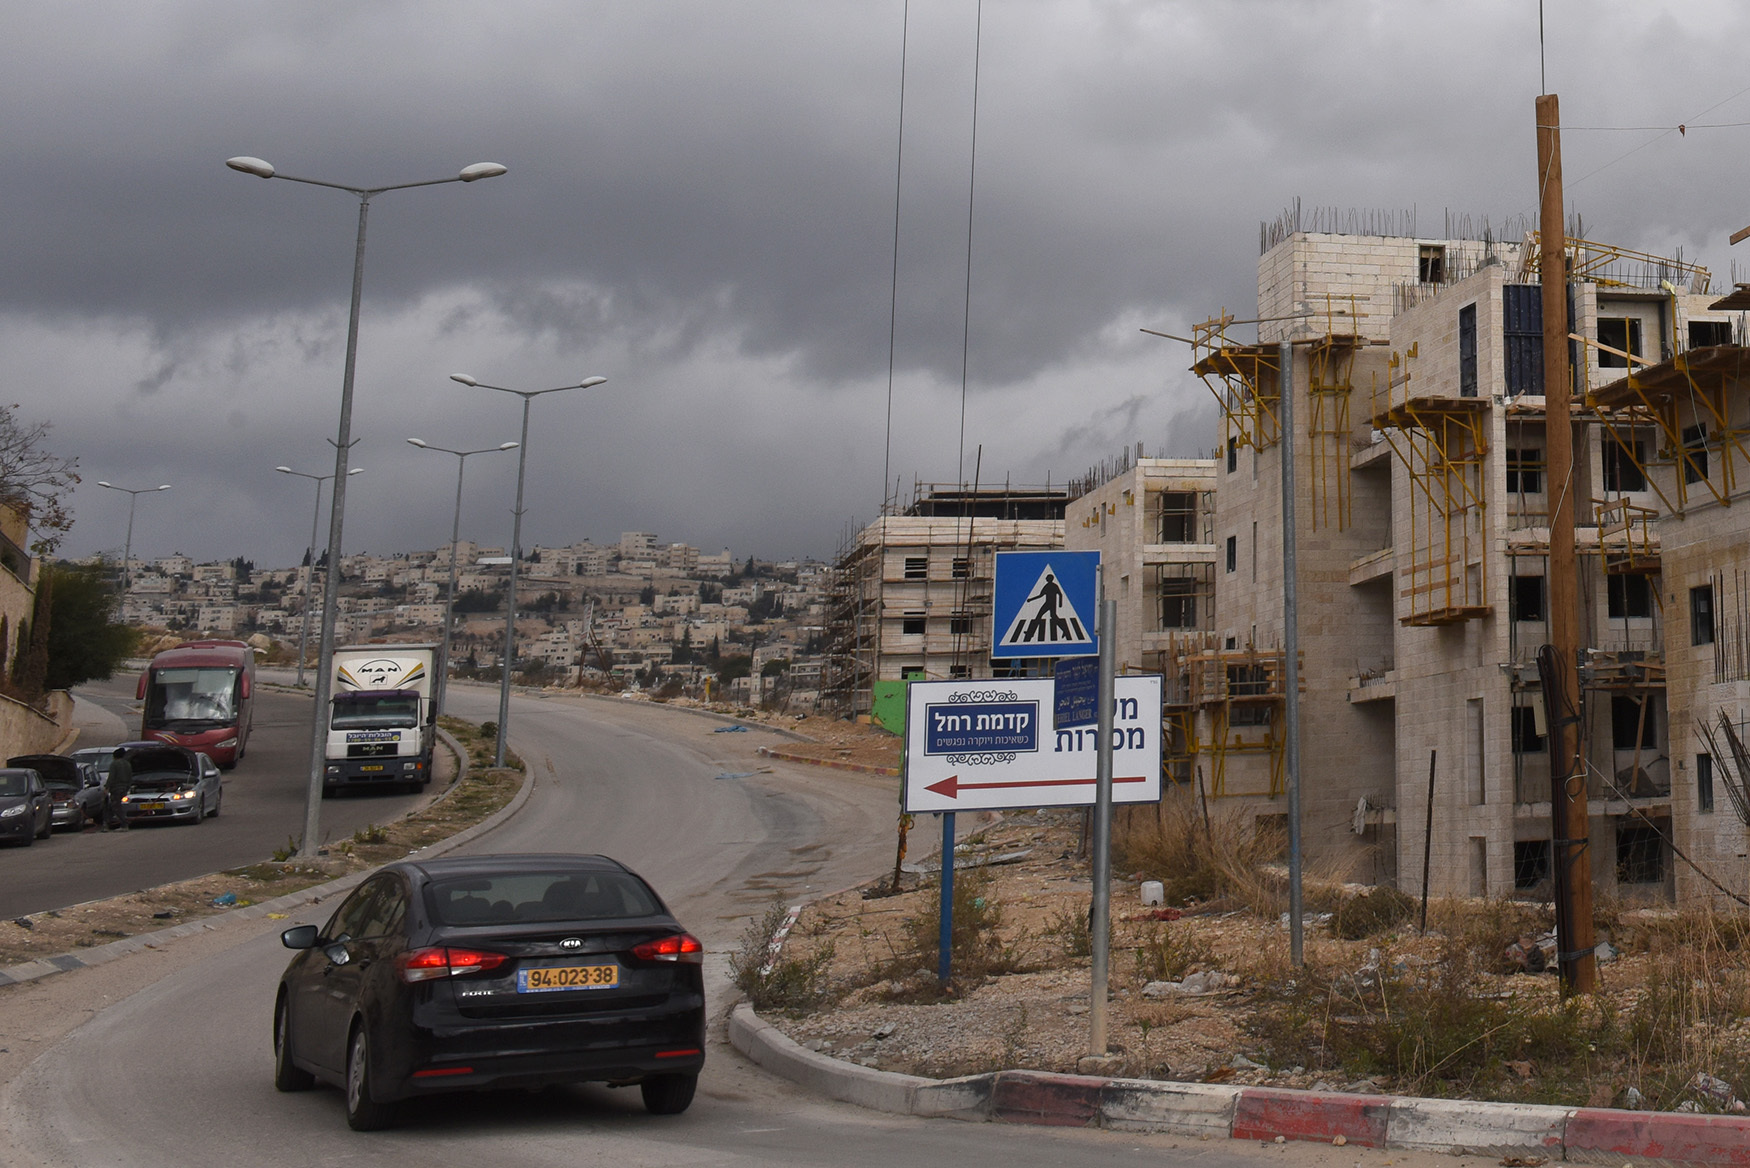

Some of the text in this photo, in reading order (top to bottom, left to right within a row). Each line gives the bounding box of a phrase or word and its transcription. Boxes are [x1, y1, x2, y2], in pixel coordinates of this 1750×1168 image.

[935, 712, 1029, 733] קדמת רחל
[936, 735, 1029, 747] כשאיכות ויוקרה נפגשים
[1054, 727, 1145, 752] מכרות
